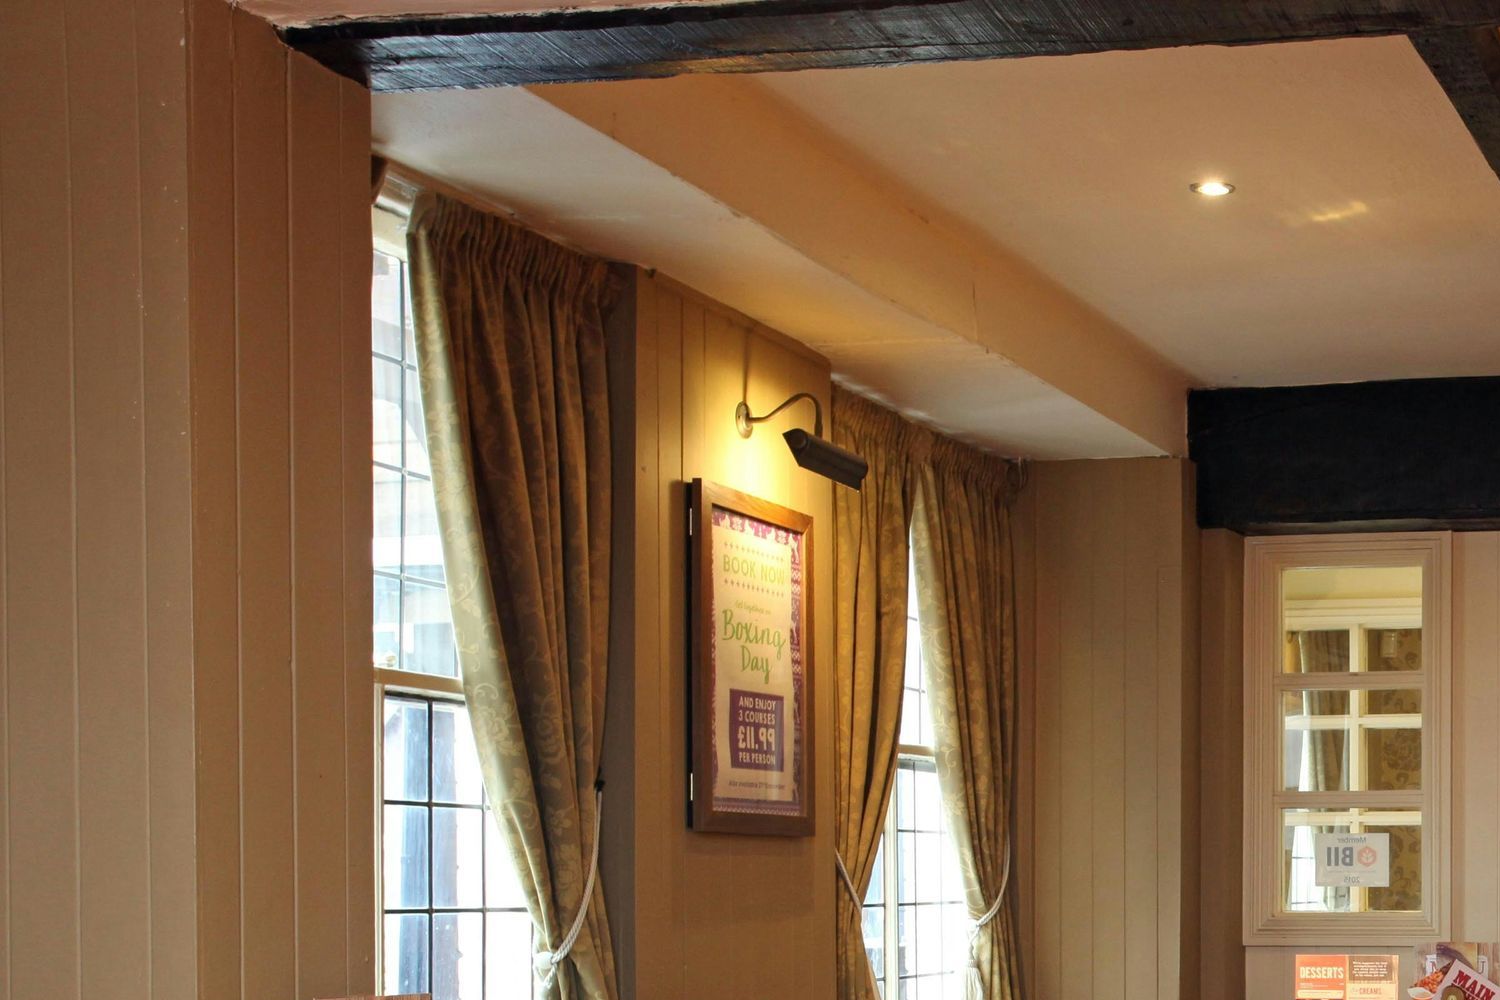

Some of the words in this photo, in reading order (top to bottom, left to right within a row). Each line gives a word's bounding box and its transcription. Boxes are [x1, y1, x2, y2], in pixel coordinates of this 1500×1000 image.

[723, 554, 756, 579] BOOK
[761, 564, 785, 585] NOW
[722, 609, 786, 661] Boxing
[741, 645, 772, 684] Day
[739, 695, 754, 708] AND
[755, 698, 777, 711] ENJOY
[738, 710, 743, 721] 3
[745, 710, 776, 725] COURSES
[738, 725, 776, 752] £11.99
[739, 752, 751, 763] PER
[752, 753, 776, 765] PERSON
[1299, 966, 1345, 979] DESSERTS
